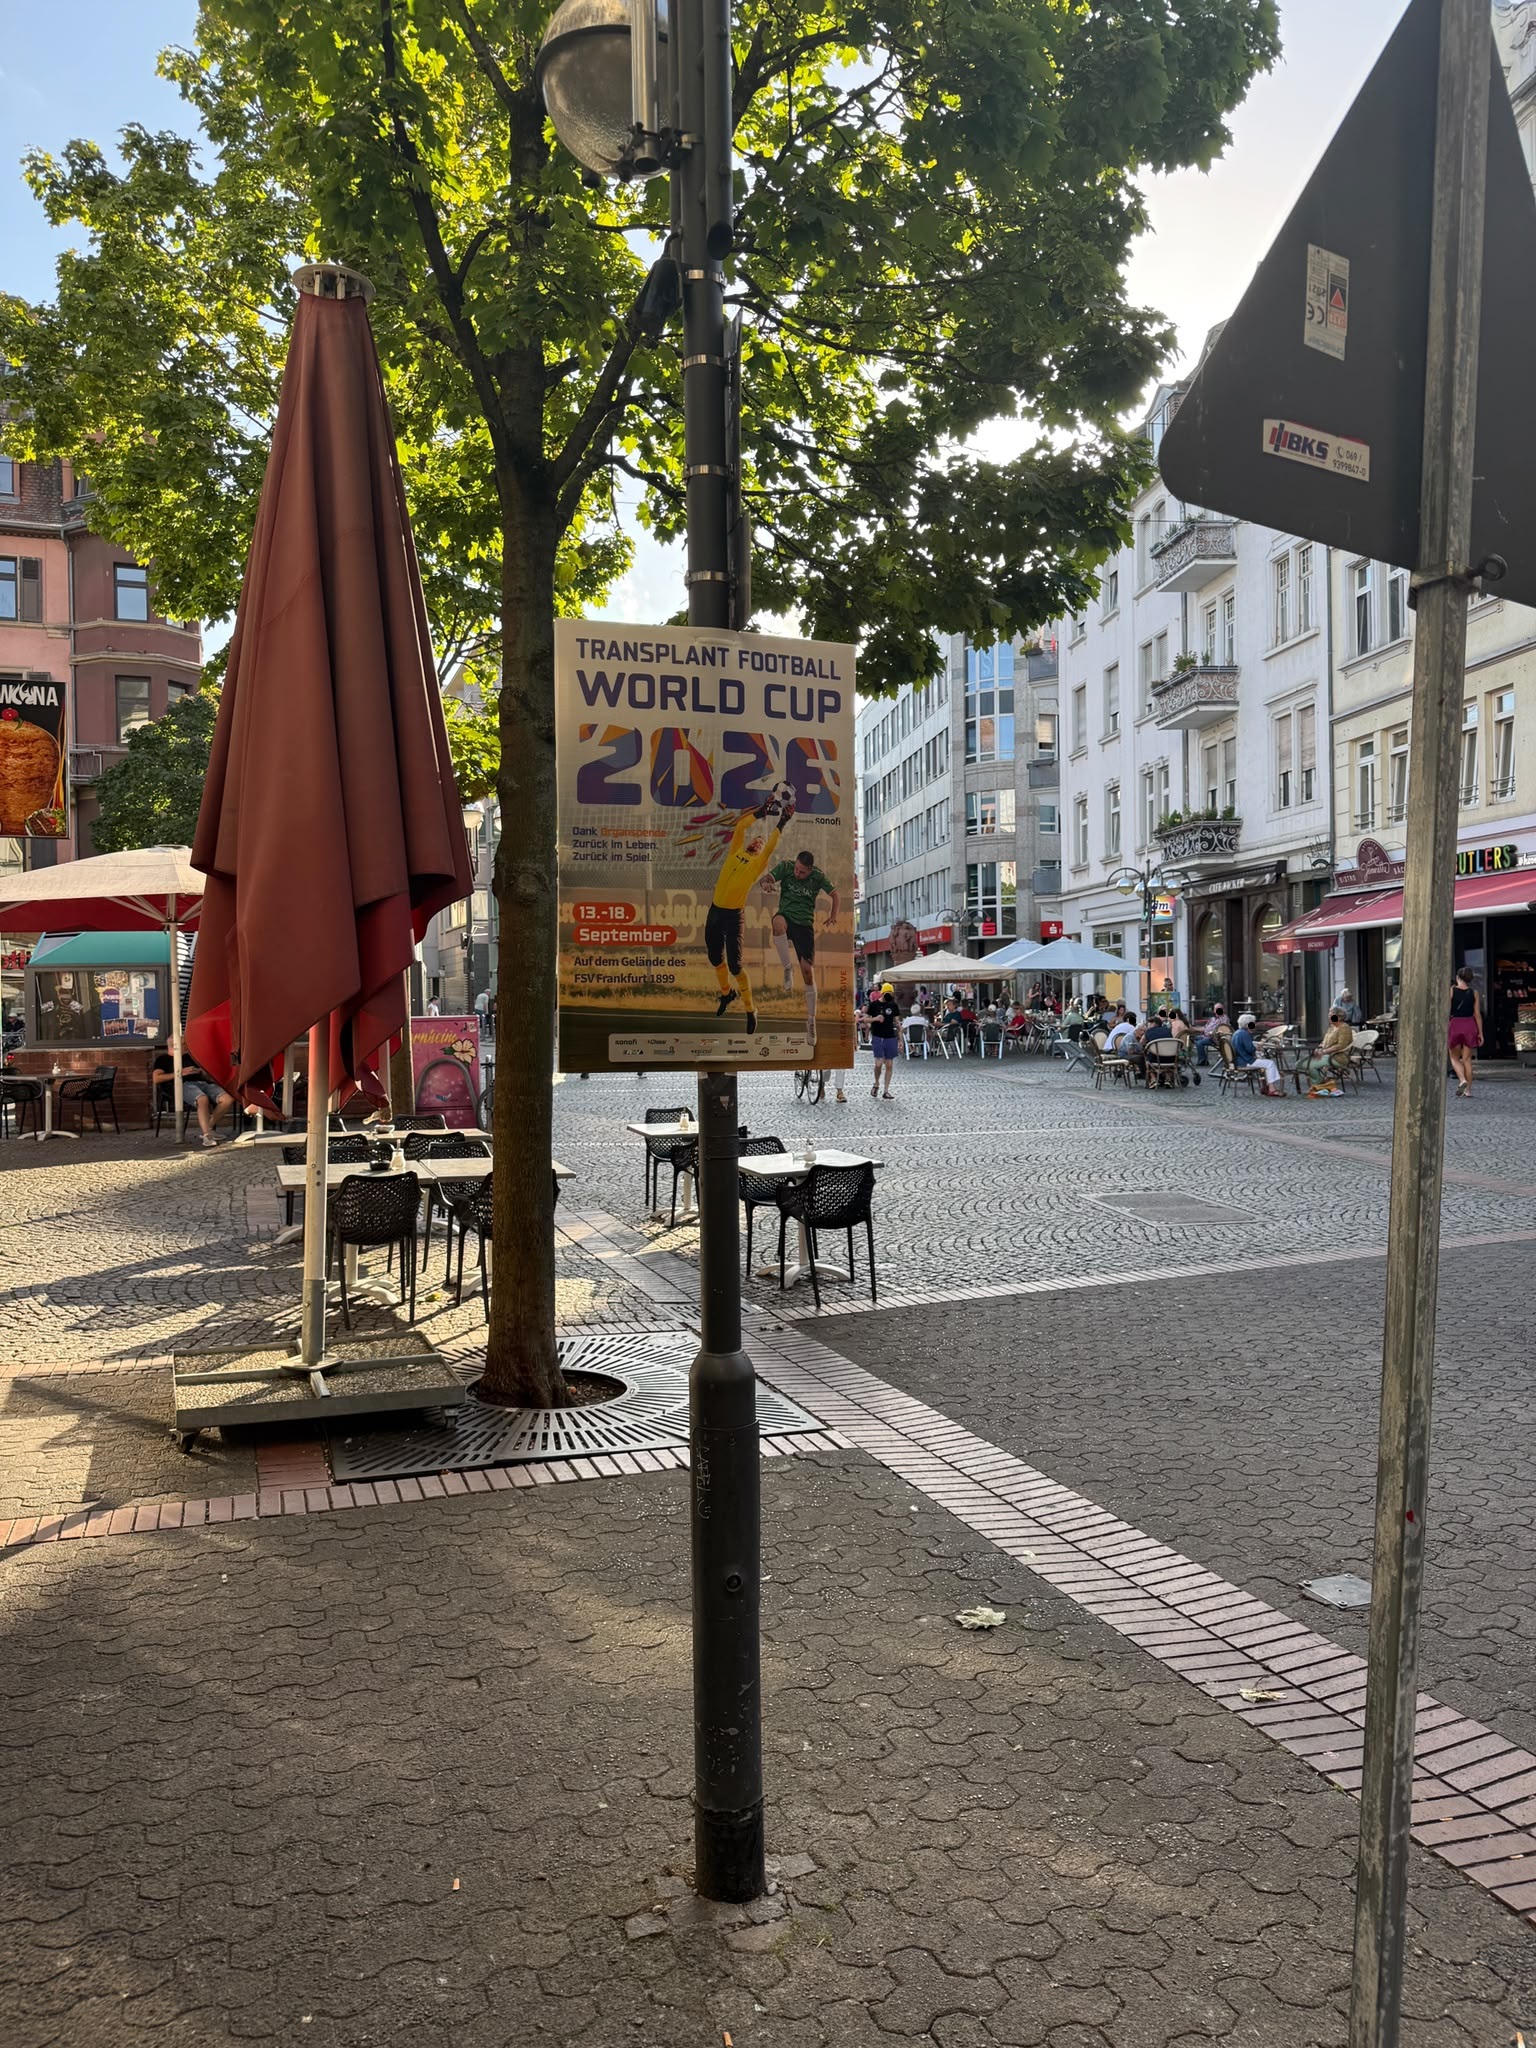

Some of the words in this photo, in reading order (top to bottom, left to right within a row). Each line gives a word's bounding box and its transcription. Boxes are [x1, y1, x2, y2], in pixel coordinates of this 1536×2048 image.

[1287, 432, 1330, 460] BKS
[1345, 450, 1358, 460] 069
[575, 638, 730, 668] TRANSPLANT
[738, 650, 842, 680] FOOTBALL
[576, 669, 745, 715] WORLD
[764, 683, 841, 723] CUP
[577, 723, 841, 815] 2026
[815, 817, 841, 826] sanofi
[572, 827, 598, 836] Dank
[600, 828, 667, 838] Organspende
[572, 839, 608, 849] Zurück
[626, 841, 659, 850] Leben.
[572, 851, 608, 861] Zurück
[611, 852, 623, 861] im
[625, 853, 652, 863] Spiel.
[1455, 845, 1511, 875] UTLERS
[579, 906, 630, 919] 13.-18.
[579, 928, 671, 944] September
[574, 956, 593, 967] Auf
[594, 957, 619, 967] dem
[621, 956, 665, 967] Gelände
[667, 957, 686, 967] des
[574, 974, 595, 984] FSV
[597, 973, 647, 984] Frankfurt
[650, 974, 675, 984] 1899
